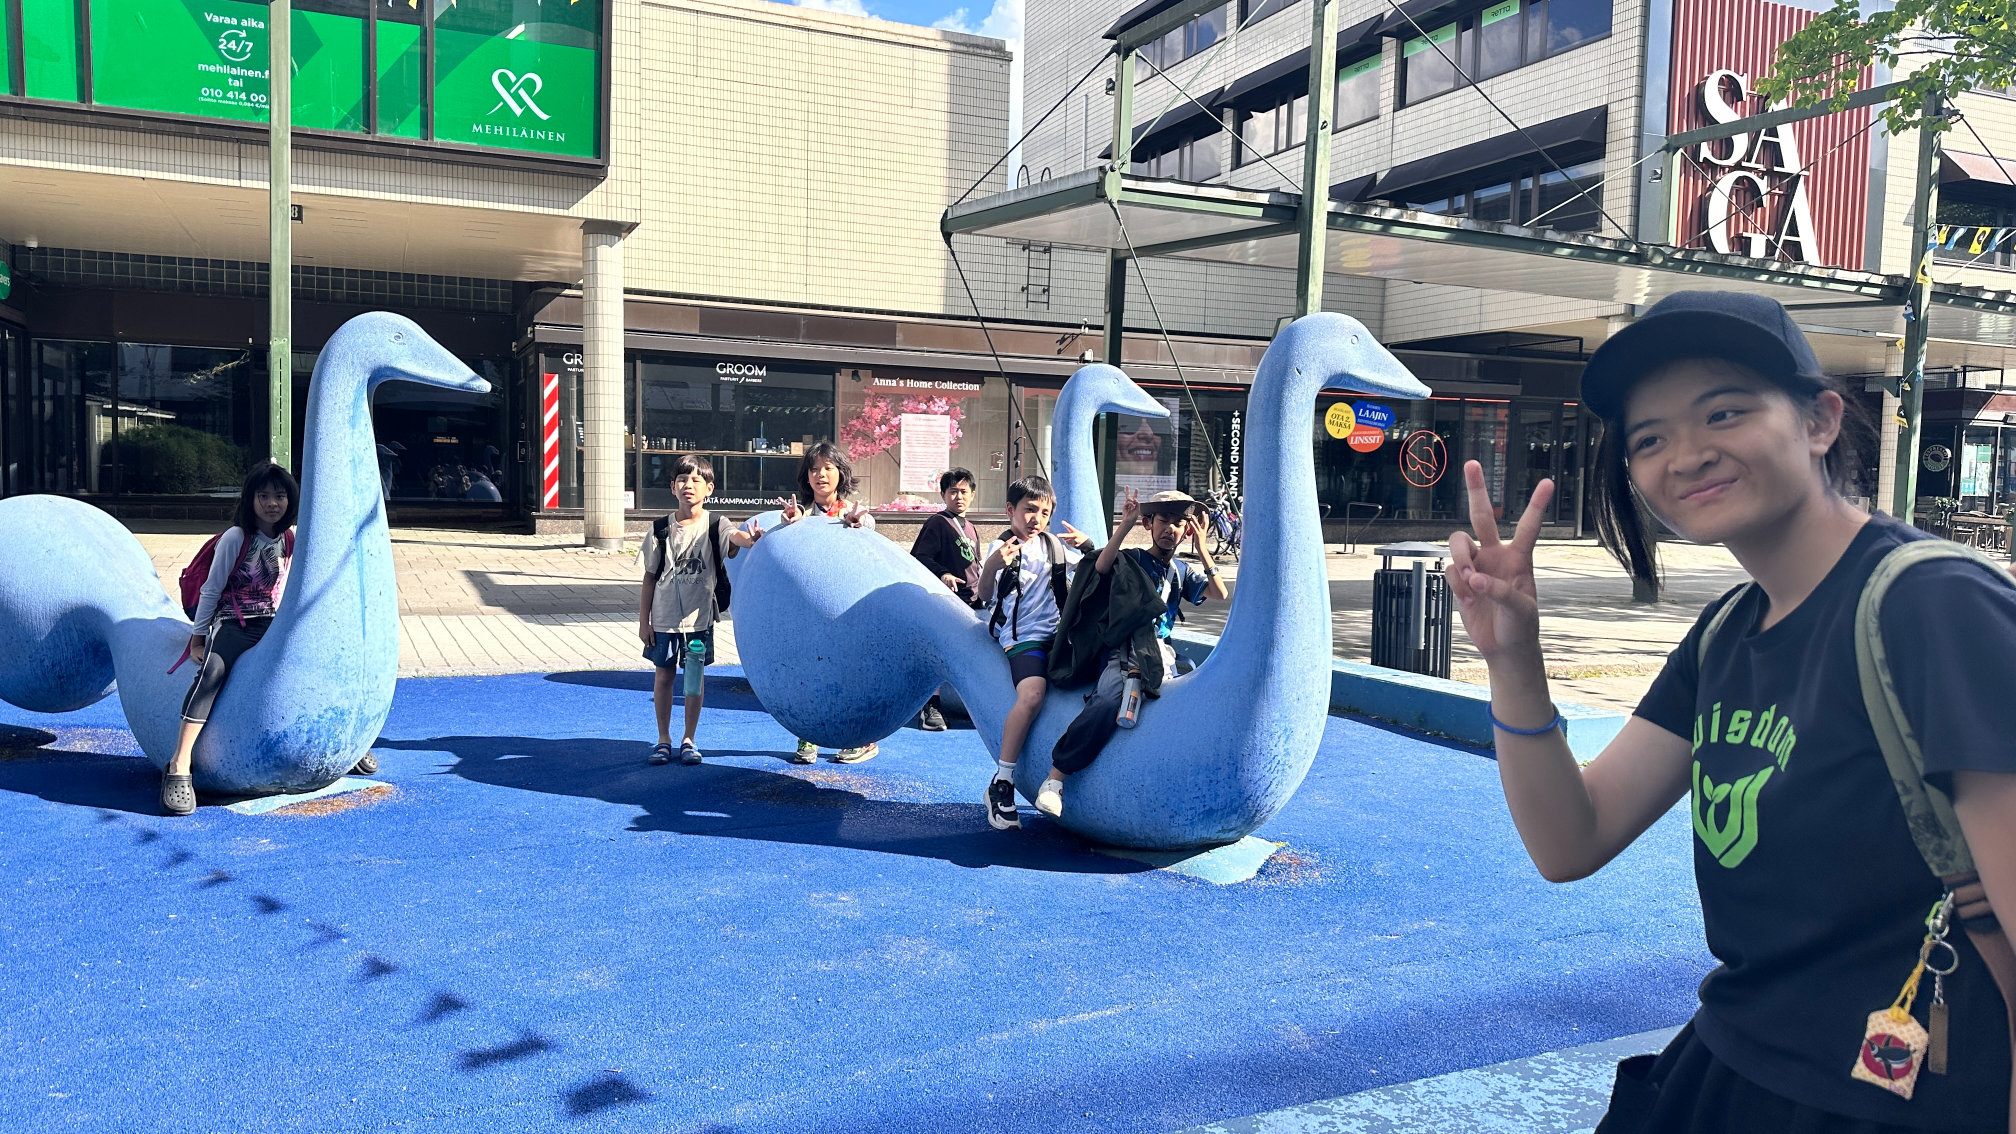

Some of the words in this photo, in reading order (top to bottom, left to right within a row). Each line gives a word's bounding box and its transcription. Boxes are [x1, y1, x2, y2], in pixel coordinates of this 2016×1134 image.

[204, 12, 238, 25] Varaa
[240, 18, 265, 29] aika
[218, 38, 254, 53] 24/7
[228, 77, 243, 88] tai
[201, 87, 223, 98] 010
[226, 90, 247, 101] 414
[472, 123, 566, 142] MEHILÄINEN
[716, 362, 767, 377] GROOM
[906, 379, 932, 389] Home
[935, 380, 980, 391] Collection
[1331, 412, 1345, 422] OTA
[1358, 408, 1389, 422] LAAJIN
[1328, 419, 1351, 430] MAKSA
[1350, 435, 1382, 445] LINSSIT
[1229, 466, 1239, 499] HAND
[720, 497, 764, 505] KAMPAAMOT
